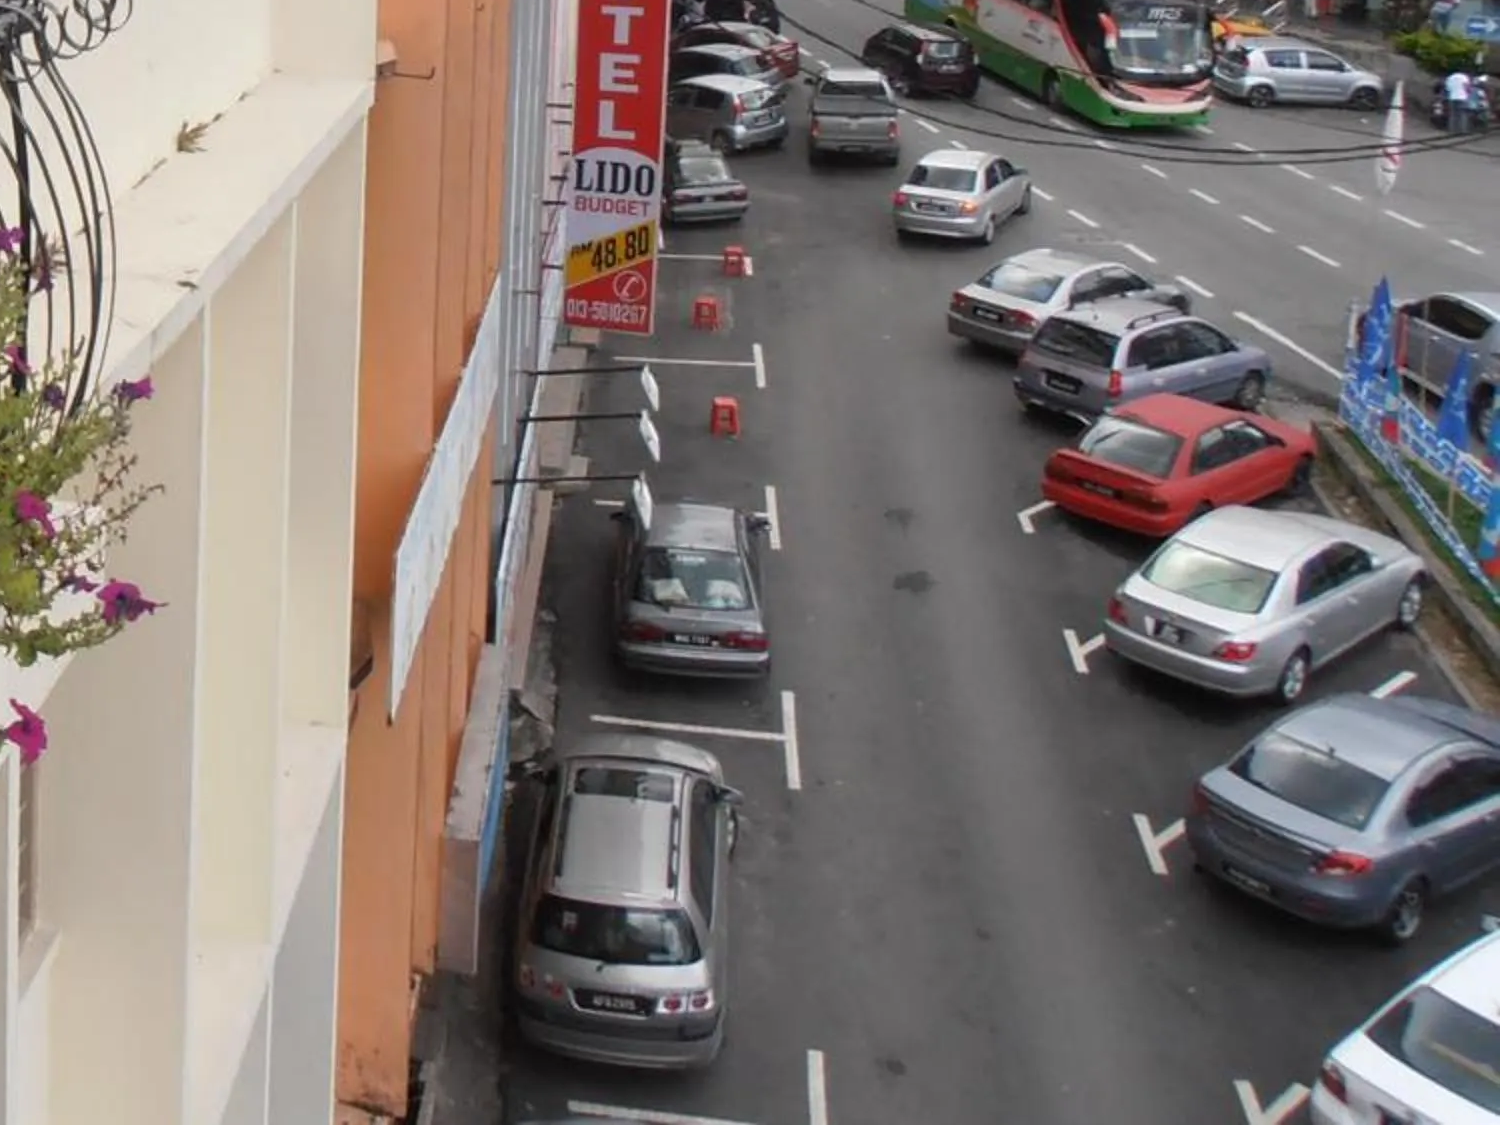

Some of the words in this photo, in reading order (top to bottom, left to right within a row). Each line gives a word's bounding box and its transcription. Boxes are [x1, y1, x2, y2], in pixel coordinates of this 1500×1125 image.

[574, 159, 655, 197] LIDO
[574, 195, 651, 216] BUDGET
[591, 226, 649, 273] 48.80
